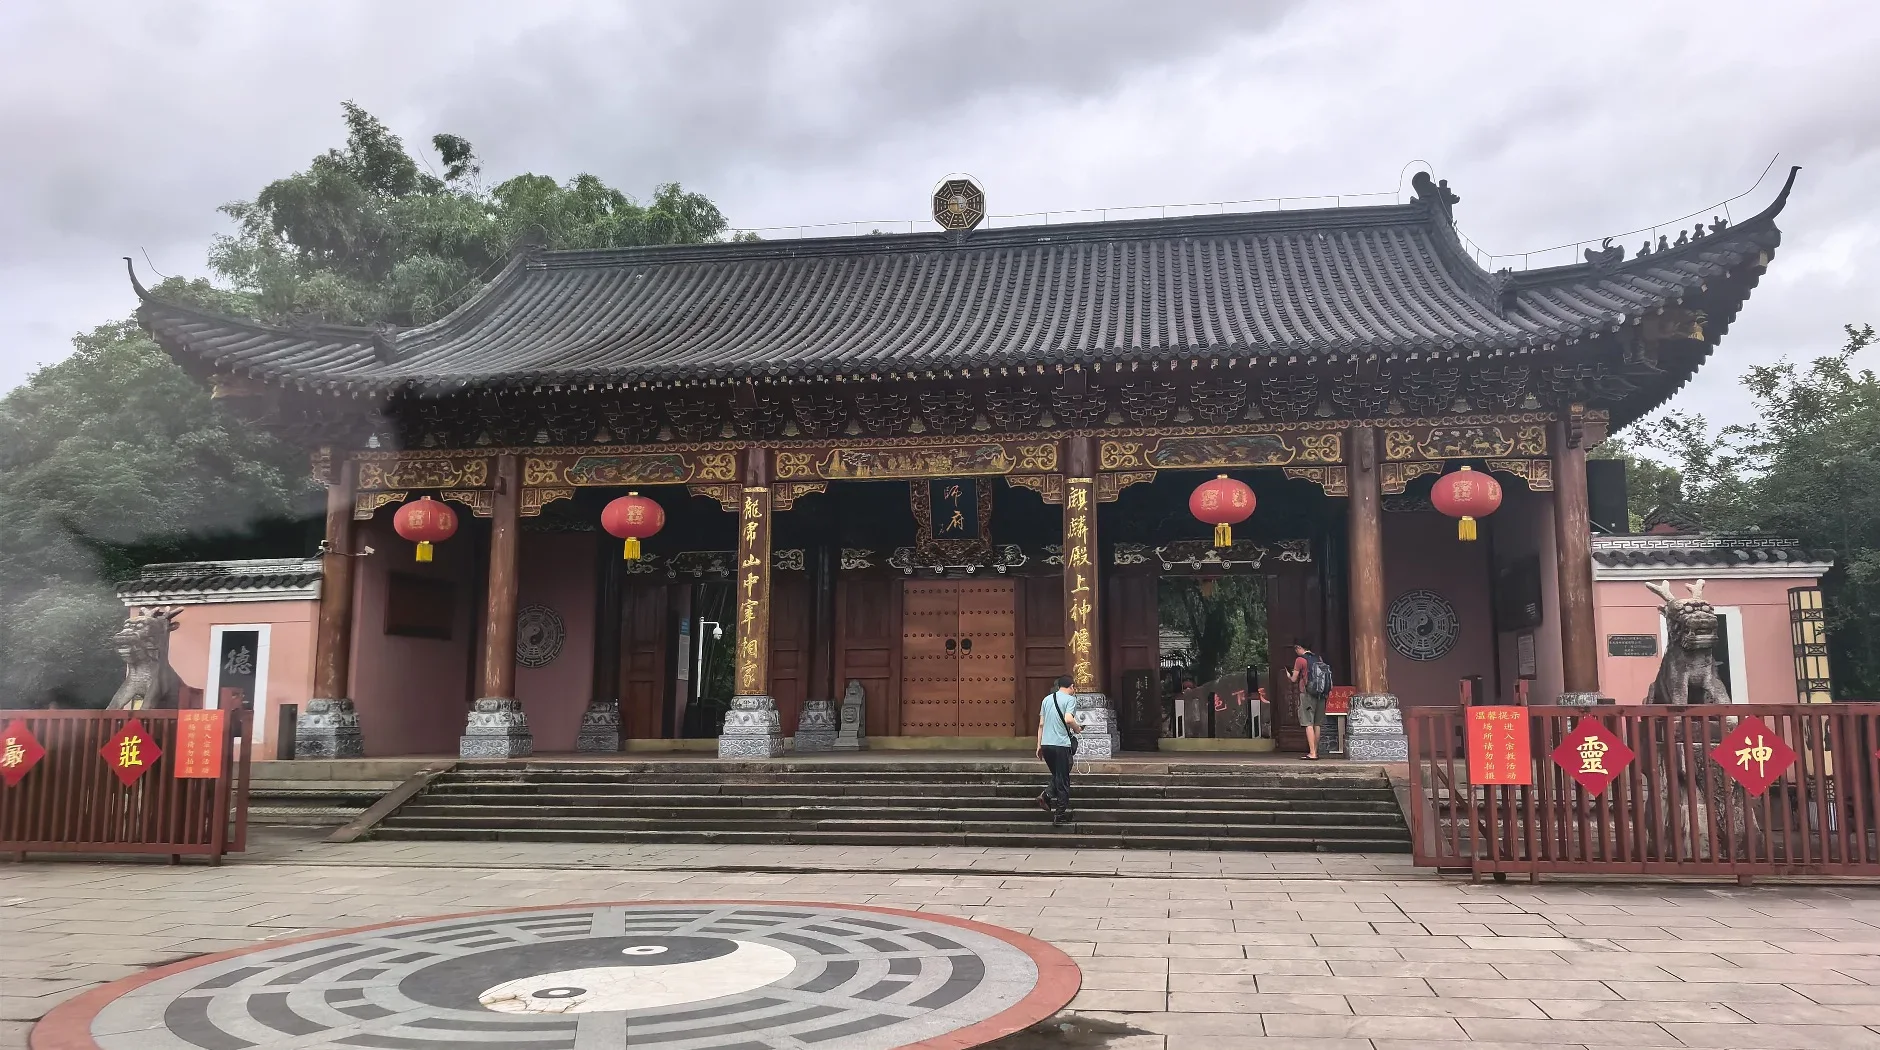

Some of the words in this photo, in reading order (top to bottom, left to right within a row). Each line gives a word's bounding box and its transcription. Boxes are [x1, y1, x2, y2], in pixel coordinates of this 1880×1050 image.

[1475, 711, 1521, 721] 温馨提示
[118, 735, 143, 768] 莊
[1483, 722, 1496, 780] 场所请勿拍摄
[1503, 722, 1517, 780] 进入宗教活动
[1576, 735, 1609, 775] 靈
[1735, 734, 1773, 778] 神
